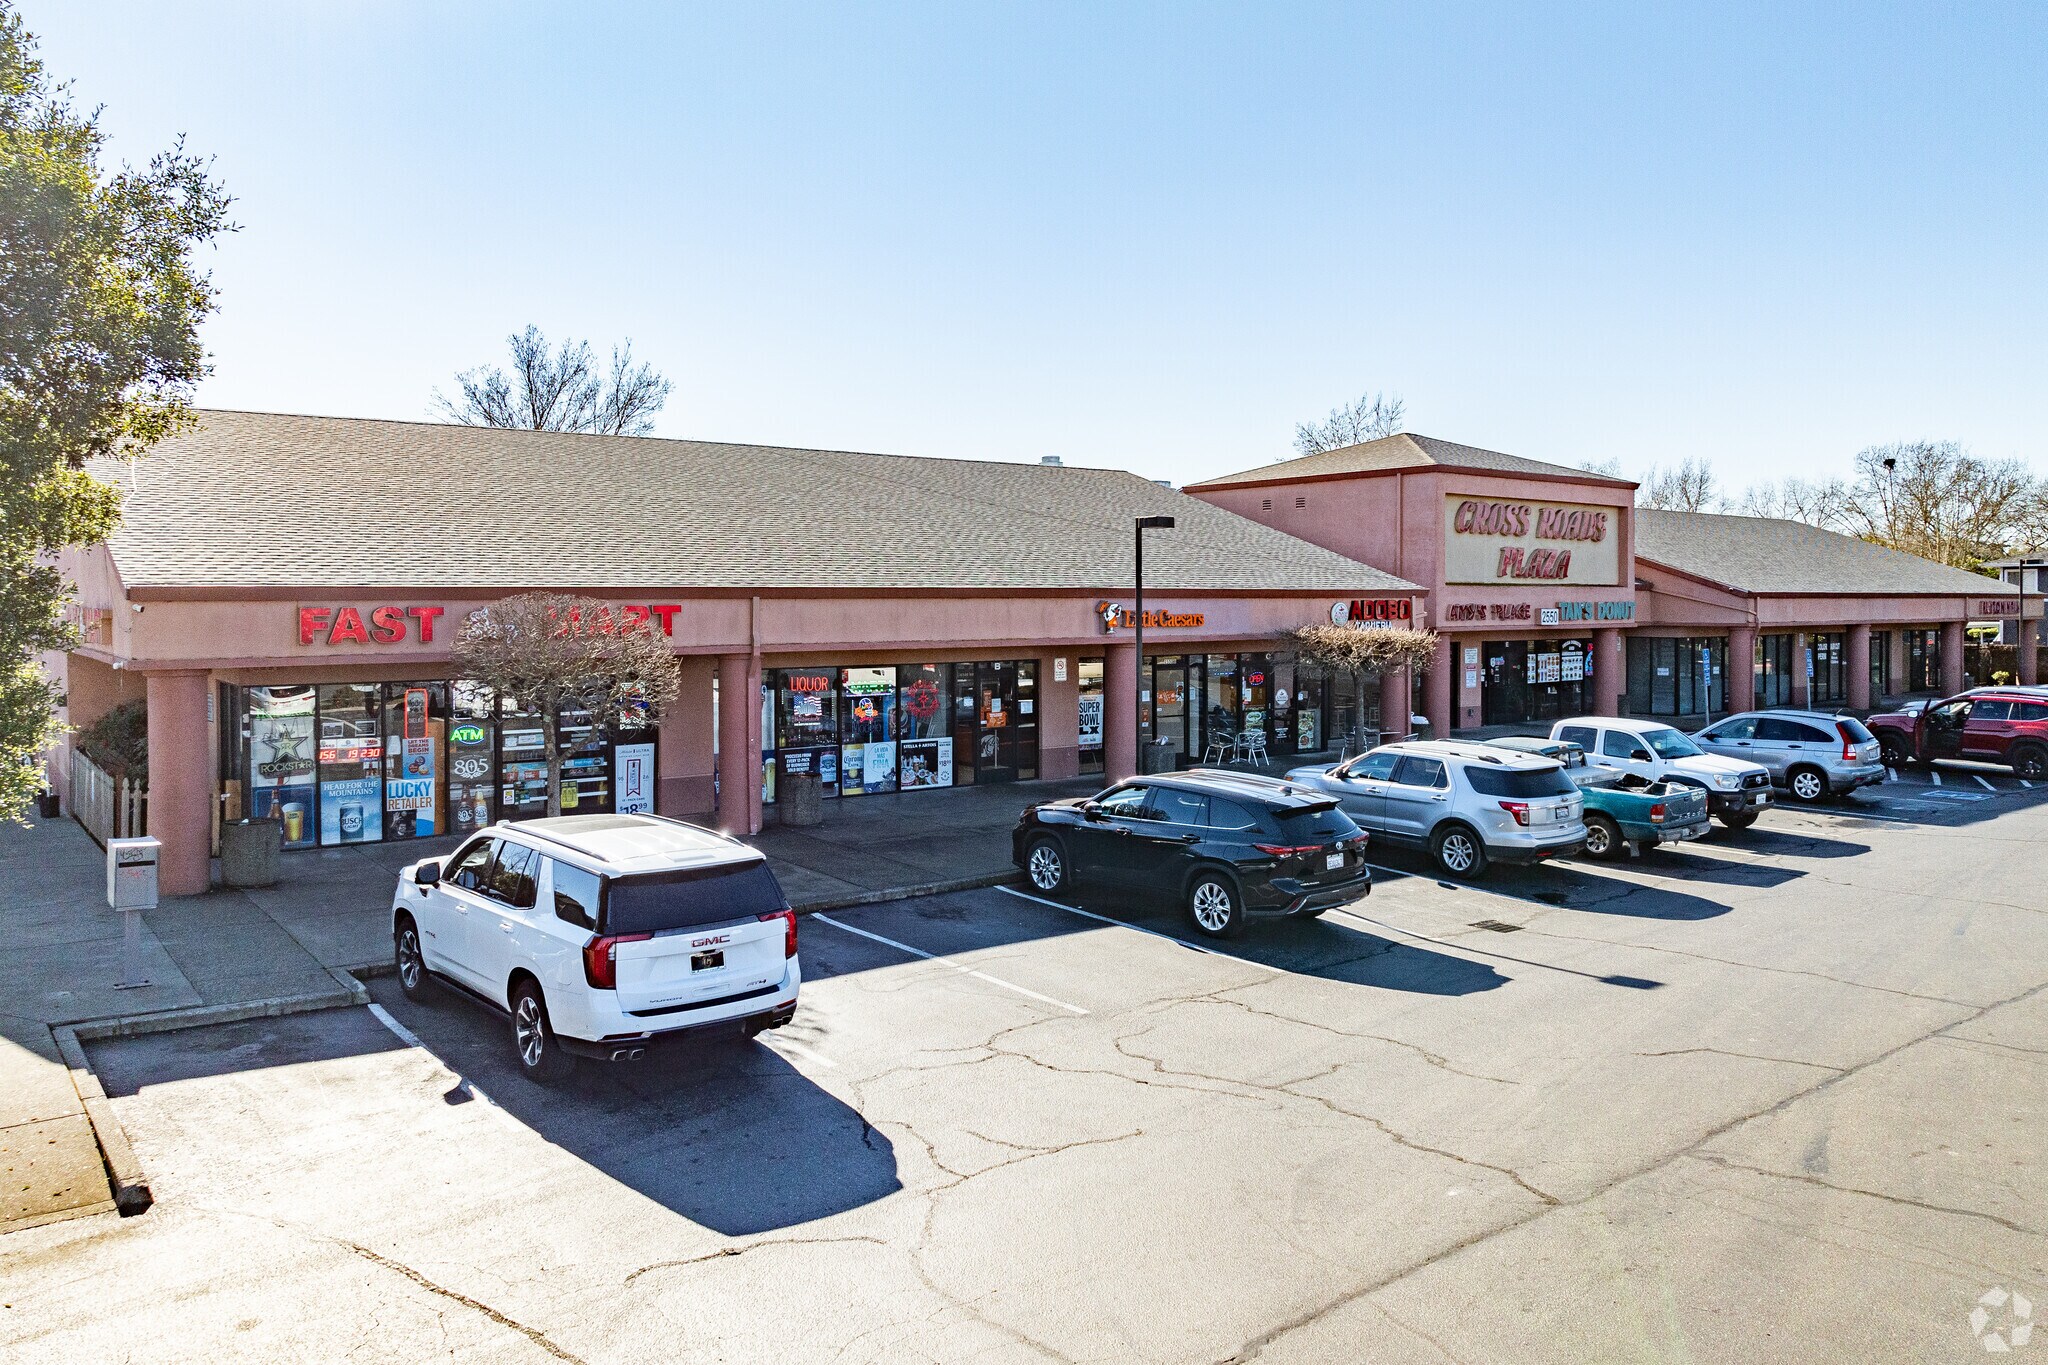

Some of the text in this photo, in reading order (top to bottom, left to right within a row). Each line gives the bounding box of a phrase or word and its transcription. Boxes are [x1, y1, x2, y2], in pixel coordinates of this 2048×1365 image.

[1454, 501, 1609, 542] CROSS ROADS
[1497, 547, 1571, 579] PLAZA
[1350, 600, 1411, 620] ADOBO
[1541, 610, 1558, 623] 2550
[1558, 602, 1636, 620] TAN'S DONUT
[300, 606, 444, 644] FAST
[1159, 609, 1205, 628] Caesars
[994, 662, 1001, 670] B
[790, 677, 829, 691] LIQUOR
[1249, 674, 1264, 683] OPEN
[1079, 702, 1100, 714] SUPER
[1079, 713, 1100, 727] BOWL
[450, 728, 484, 741] ATM
[1079, 726, 1100, 735] LX
[319, 750, 337, 759] 156
[360, 748, 381, 758] 230
[454, 758, 489, 775] 805
[324, 781, 379, 791] HEAD FOR THE
[329, 788, 374, 797] MOUNTAINS
[388, 780, 432, 799] LUCKY
[388, 797, 432, 811] RETAILER
[691, 934, 731, 948] GMC
